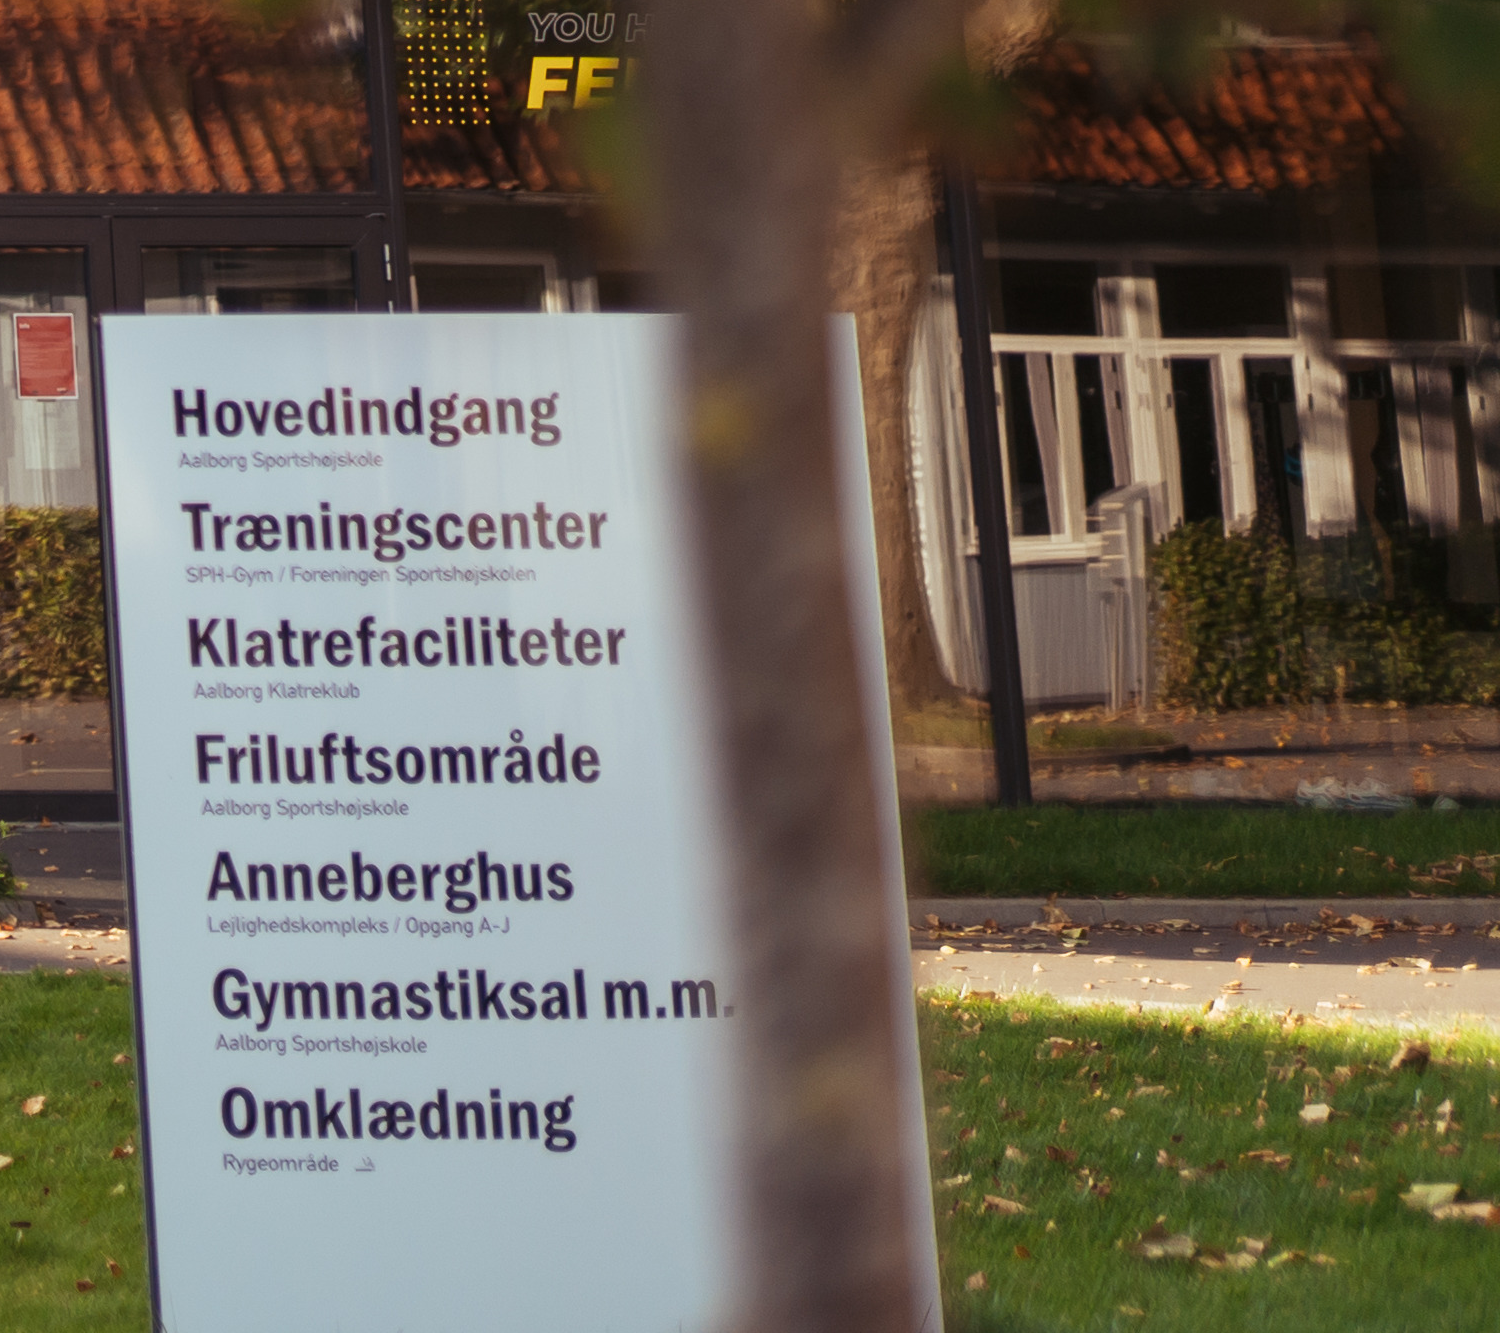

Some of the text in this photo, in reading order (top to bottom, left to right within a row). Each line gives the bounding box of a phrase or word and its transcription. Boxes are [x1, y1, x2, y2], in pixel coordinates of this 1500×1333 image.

[527, 12, 616, 43] YOU
[526, 56, 640, 110] FE
[172, 386, 562, 447] Hovedindgang
[178, 451, 384, 472] Aalborg Sportshøjskole
[180, 501, 608, 563] Træningscenter
[185, 566, 274, 587] SPH-Gym
[290, 565, 390, 586] Foreningen
[395, 565, 537, 586] Sportshøjskolen
[187, 616, 626, 668] Klatrefaciliteter
[193, 682, 361, 703] Aalborg Klatreklub
[195, 729, 601, 785] Friluftsområde
[201, 798, 409, 820] Aalborg Sportshøjskole
[206, 850, 575, 914] Anneberghus
[207, 916, 389, 937] Lejlighedskompleks
[405, 916, 474, 938] Opgang
[479, 916, 510, 934] A-J
[211, 968, 736, 1031] Gymnastiksal m.m.
[215, 1033, 427, 1057] Aalborg Sportshøjskole
[220, 1087, 577, 1153] Omklædning
[222, 1152, 339, 1173] Rygeområde
